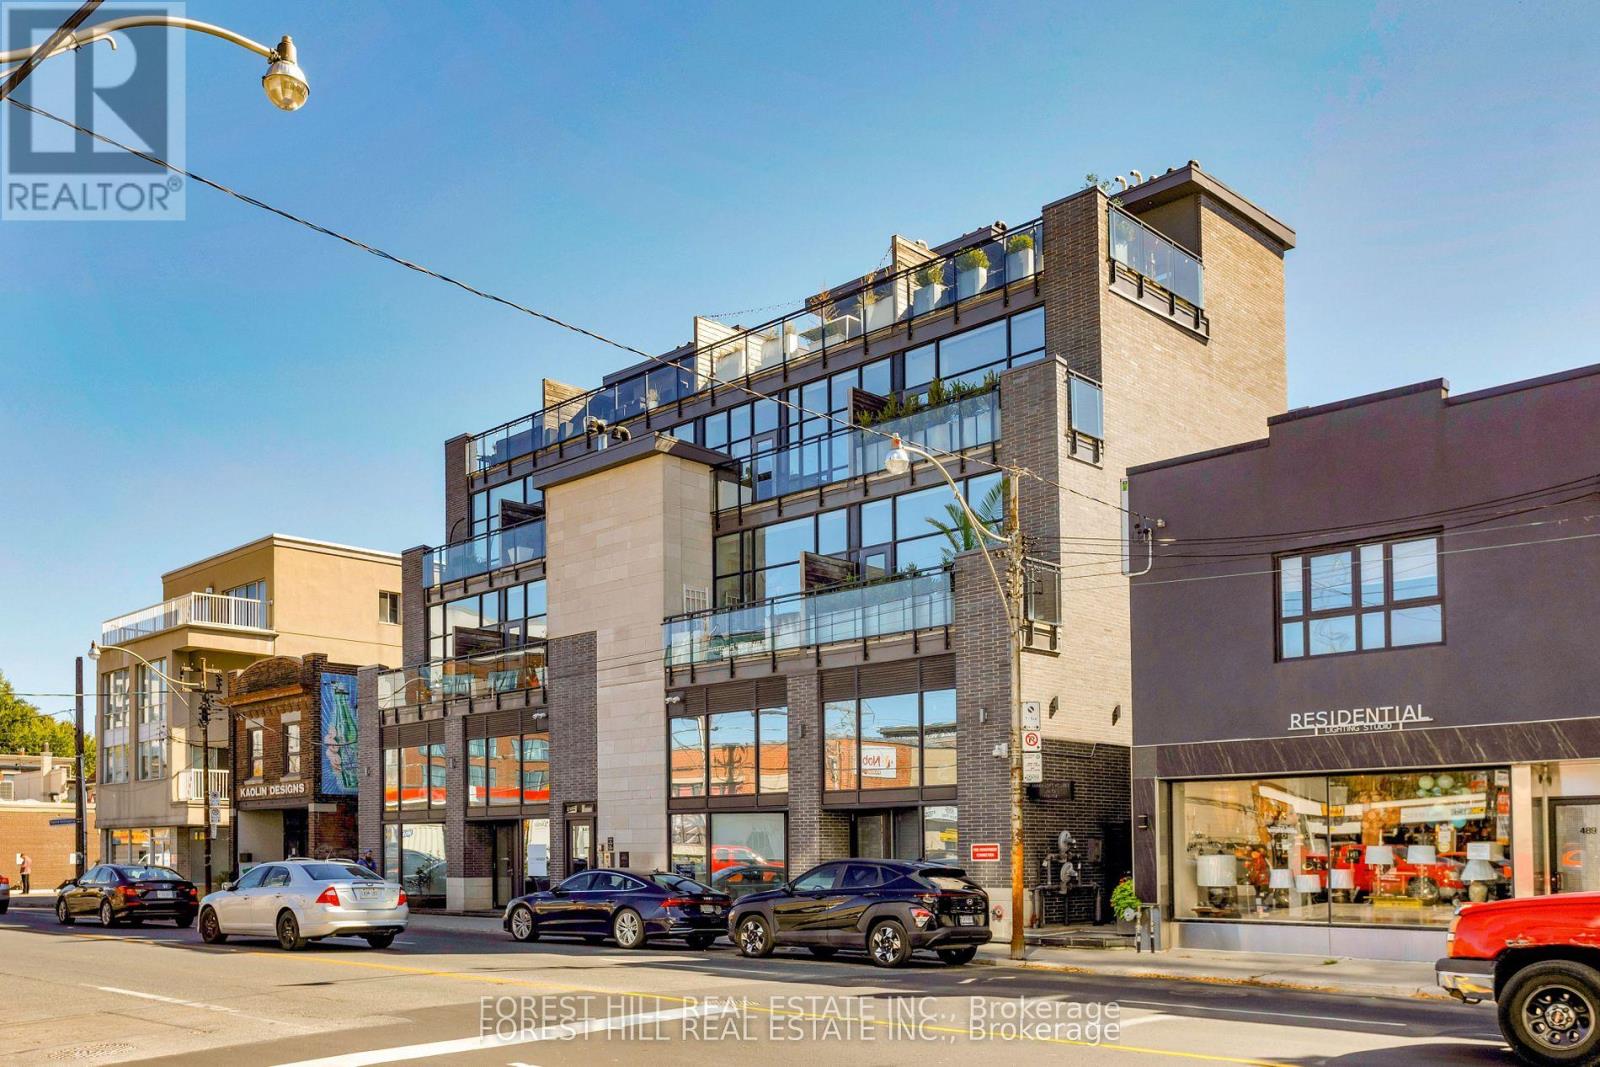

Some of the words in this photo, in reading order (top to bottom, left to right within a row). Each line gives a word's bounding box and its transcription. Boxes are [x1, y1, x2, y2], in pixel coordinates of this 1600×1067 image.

[1290, 704, 1429, 729] RESIDENTIAL
[1325, 725, 1360, 734] LIGHTING
[1363, 722, 1392, 731] STUDIO
[240, 786, 267, 798] KAOLIN
[269, 783, 305, 795] DESIGNS
[1579, 827, 1597, 835] 489
